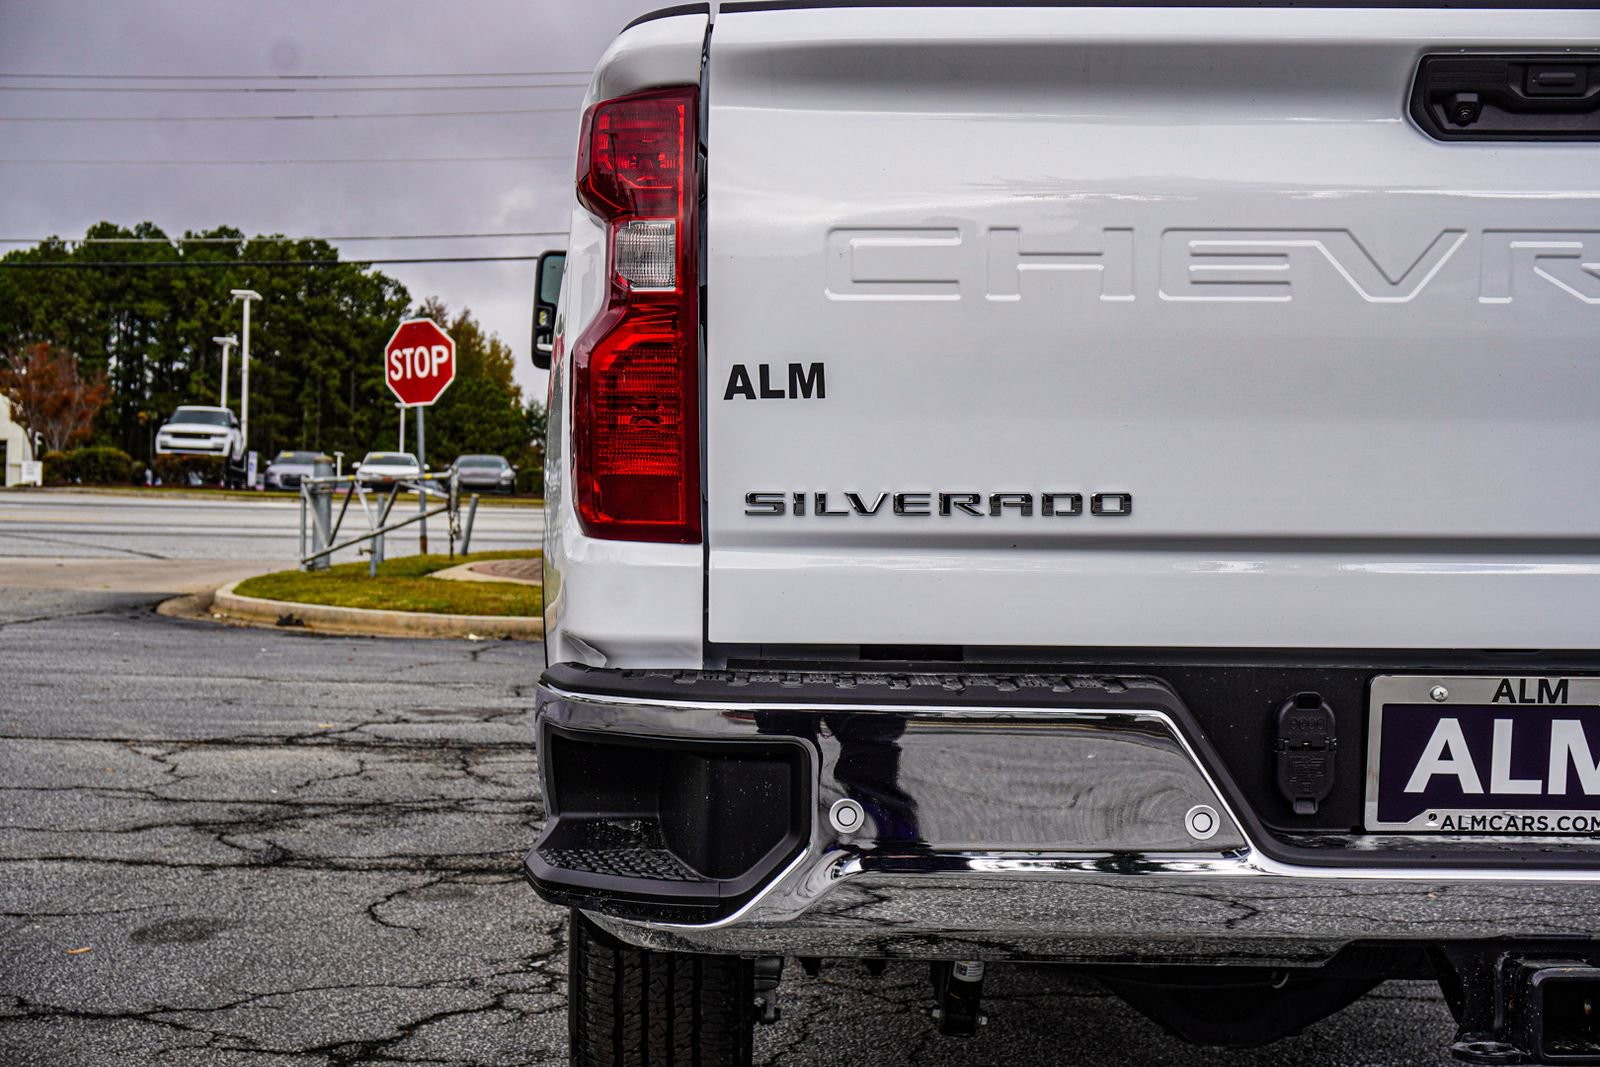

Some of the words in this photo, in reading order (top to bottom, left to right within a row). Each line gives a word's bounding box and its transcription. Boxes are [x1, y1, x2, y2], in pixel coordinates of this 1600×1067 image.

[389, 345, 449, 381] STOP
[724, 362, 826, 400] ALM
[744, 490, 1133, 518] SILVERADO
[1491, 678, 1568, 704] ALM
